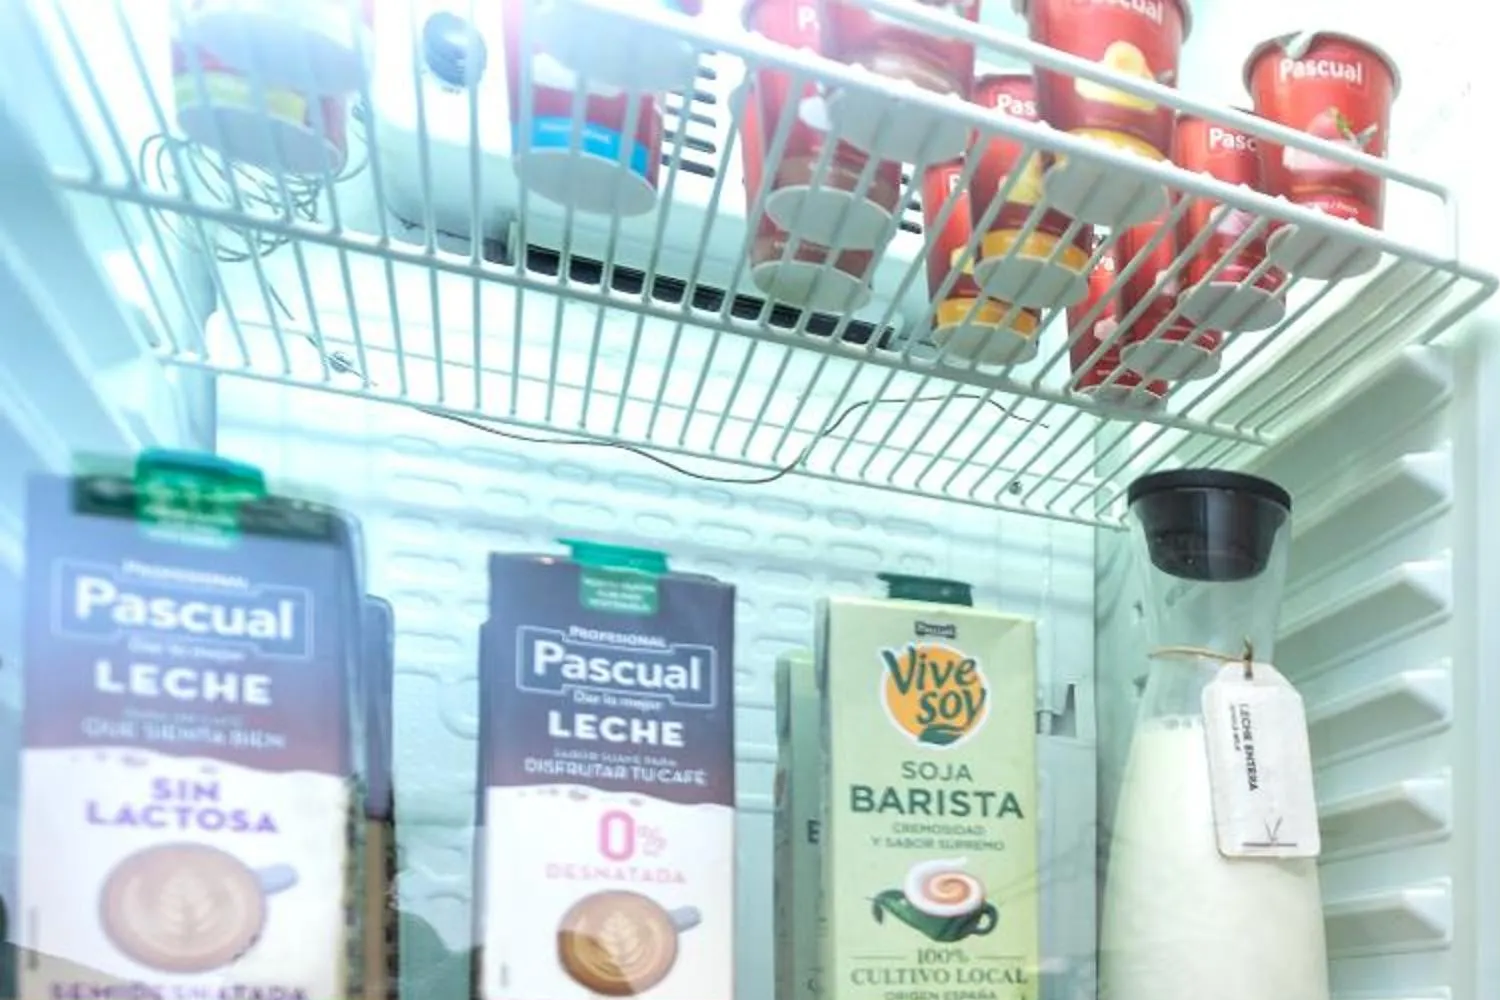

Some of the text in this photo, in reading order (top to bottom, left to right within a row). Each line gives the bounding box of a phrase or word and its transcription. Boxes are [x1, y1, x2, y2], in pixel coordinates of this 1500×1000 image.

[1279, 57, 1364, 85] Pascual
[74, 575, 294, 641] Pascual
[534, 640, 701, 690] Pascual
[883, 645, 977, 696] Vive
[94, 659, 274, 705] LECHE
[917, 688, 986, 726] soy
[548, 711, 685, 747] LECHE
[524, 757, 629, 779] DISFRUTAR
[632, 766, 654, 782] TU
[902, 761, 973, 781] SOJA
[150, 777, 221, 802] SIN
[850, 786, 1024, 819] BARISTA
[85, 802, 279, 832] LACTOSA
[871, 836, 881, 847] Y
[886, 837, 934, 849] SABOR
[545, 862, 687, 884] DESNATADA
[917, 947, 970, 964] 100%
[850, 967, 1027, 986] CULTIVO LOCAL
